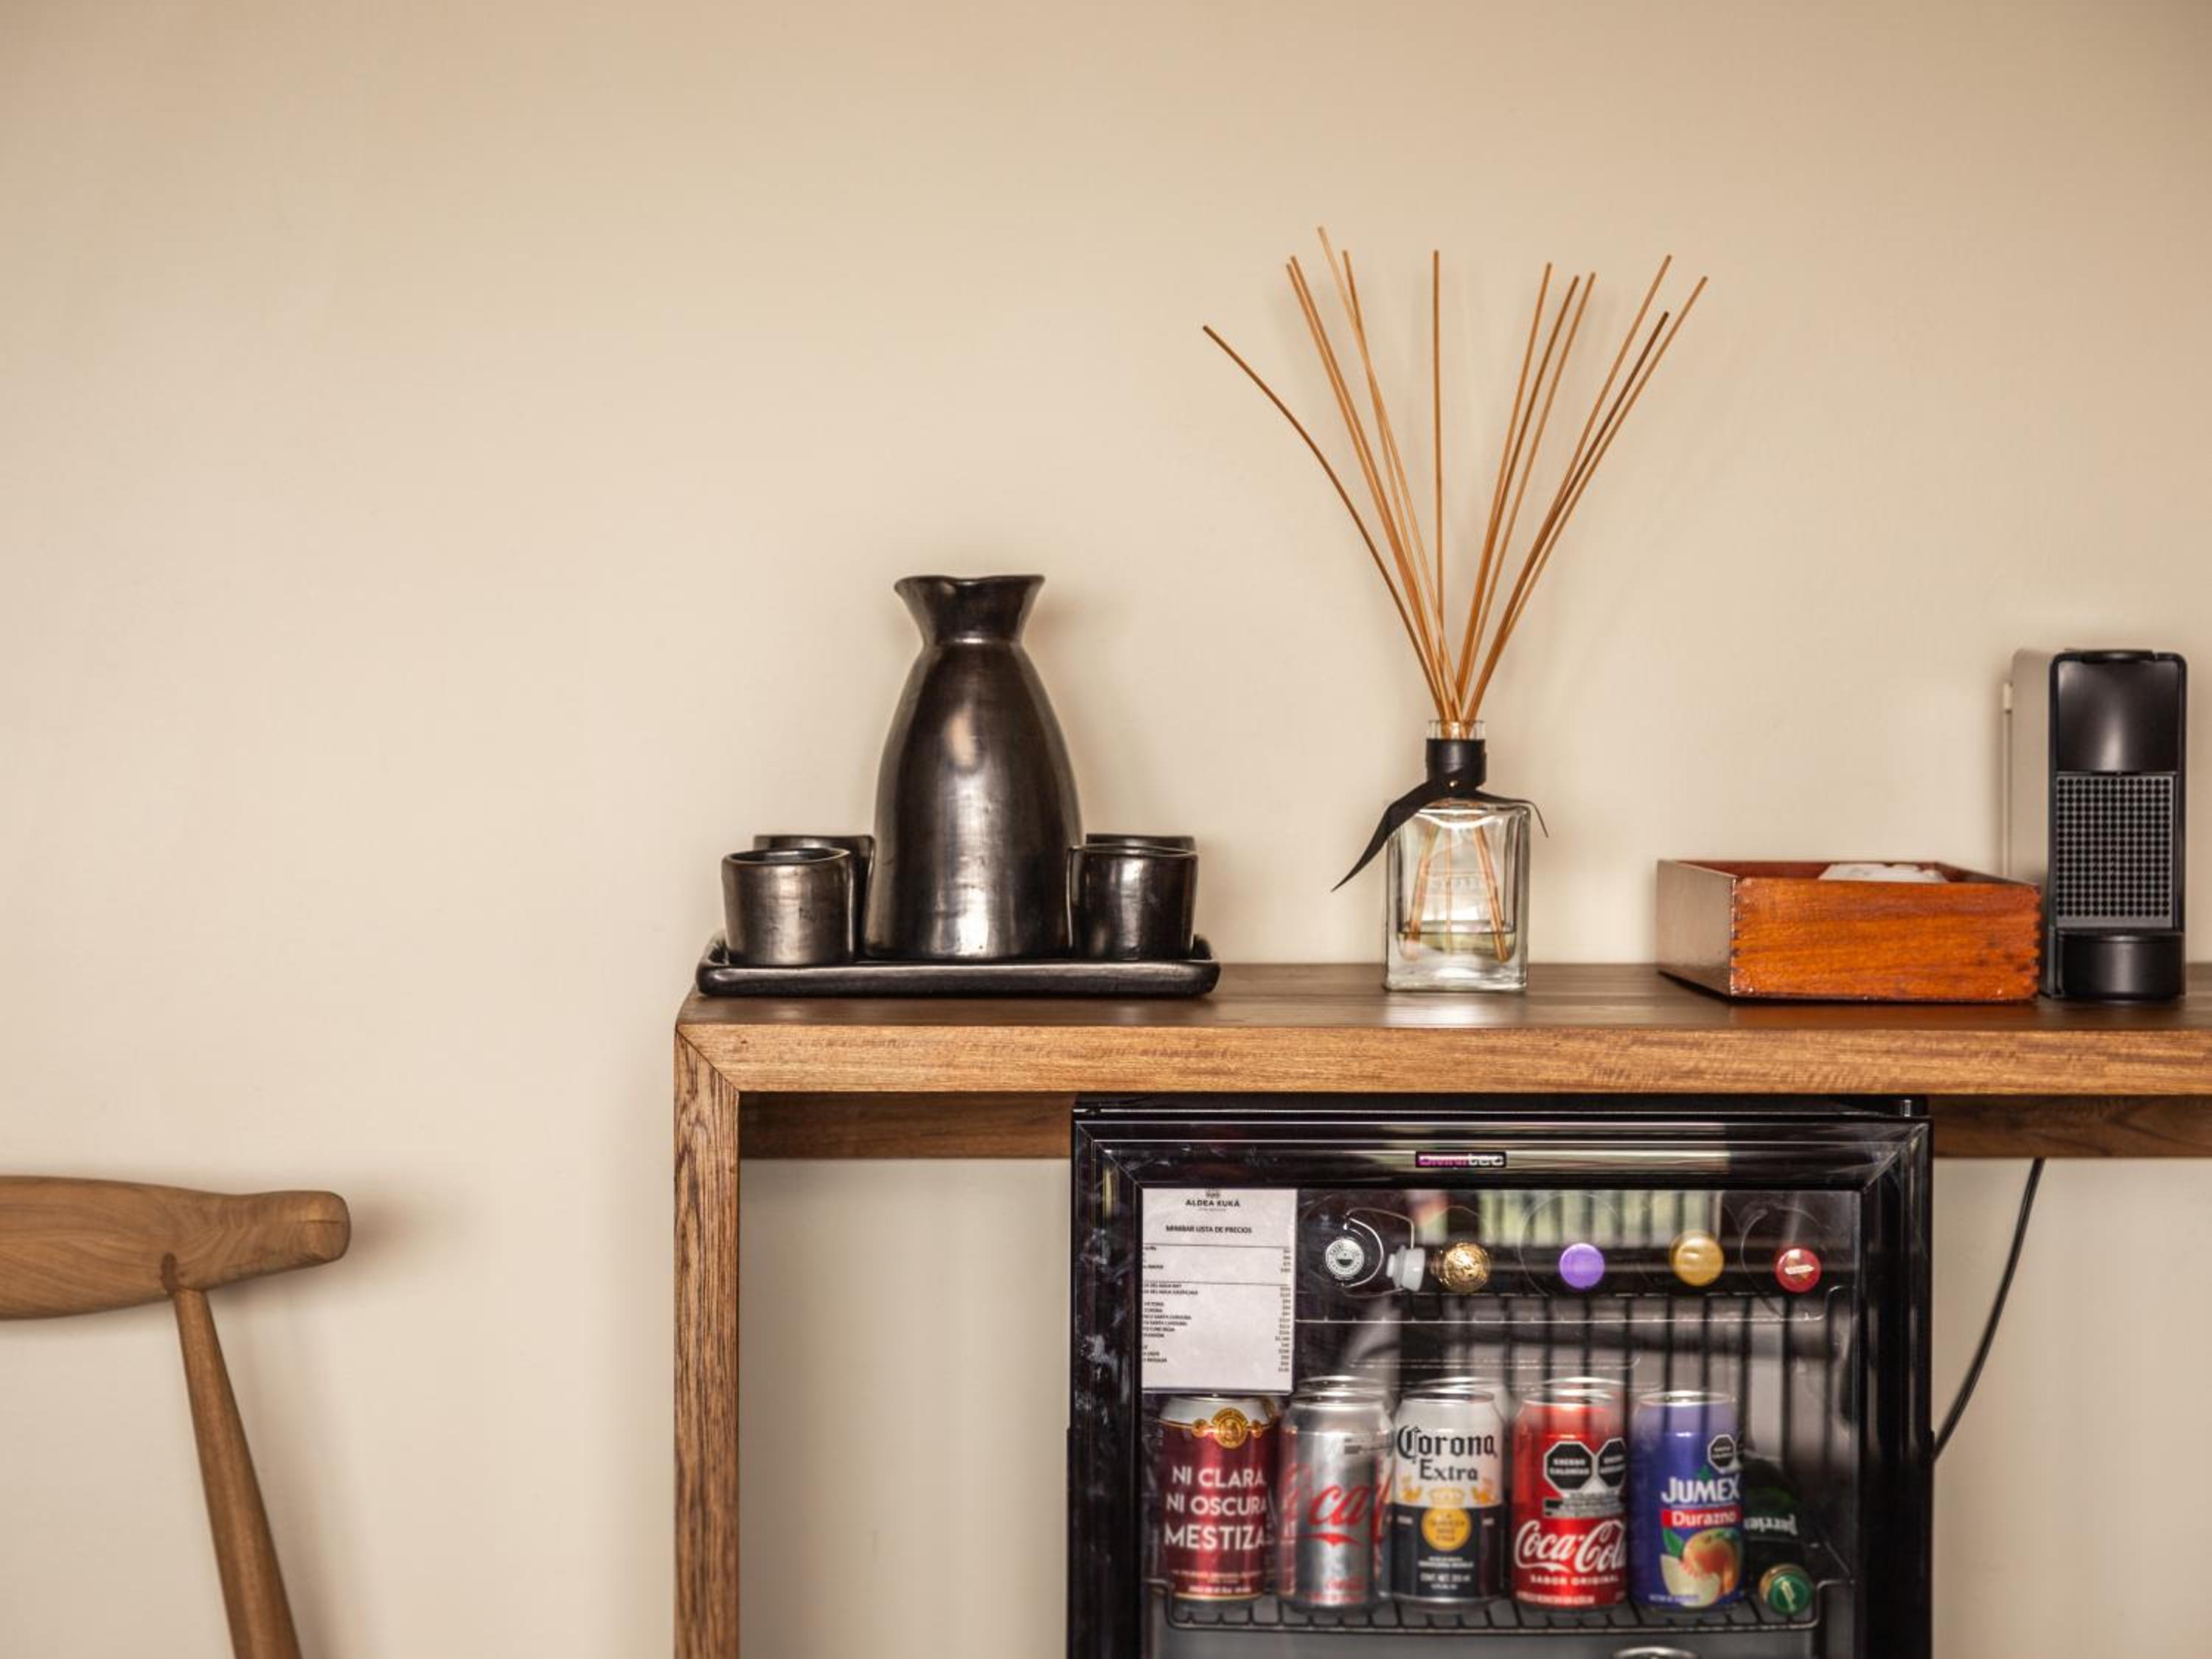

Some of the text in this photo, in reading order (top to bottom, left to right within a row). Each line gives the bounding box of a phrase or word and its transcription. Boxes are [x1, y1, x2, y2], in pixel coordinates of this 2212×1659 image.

[1397, 1425, 1498, 1464] Corona
[1172, 1465, 1266, 1489] NI CLARA
[1419, 1459, 1478, 1481] Extra
[1661, 1474, 1740, 1503] JUMEX
[1166, 1492, 1185, 1513] NI
[1672, 1509, 1736, 1527] Durazno
[1164, 1523, 1267, 1551] MESTIZA
[1530, 1574, 1619, 1585] SABOR ORIGINAL
